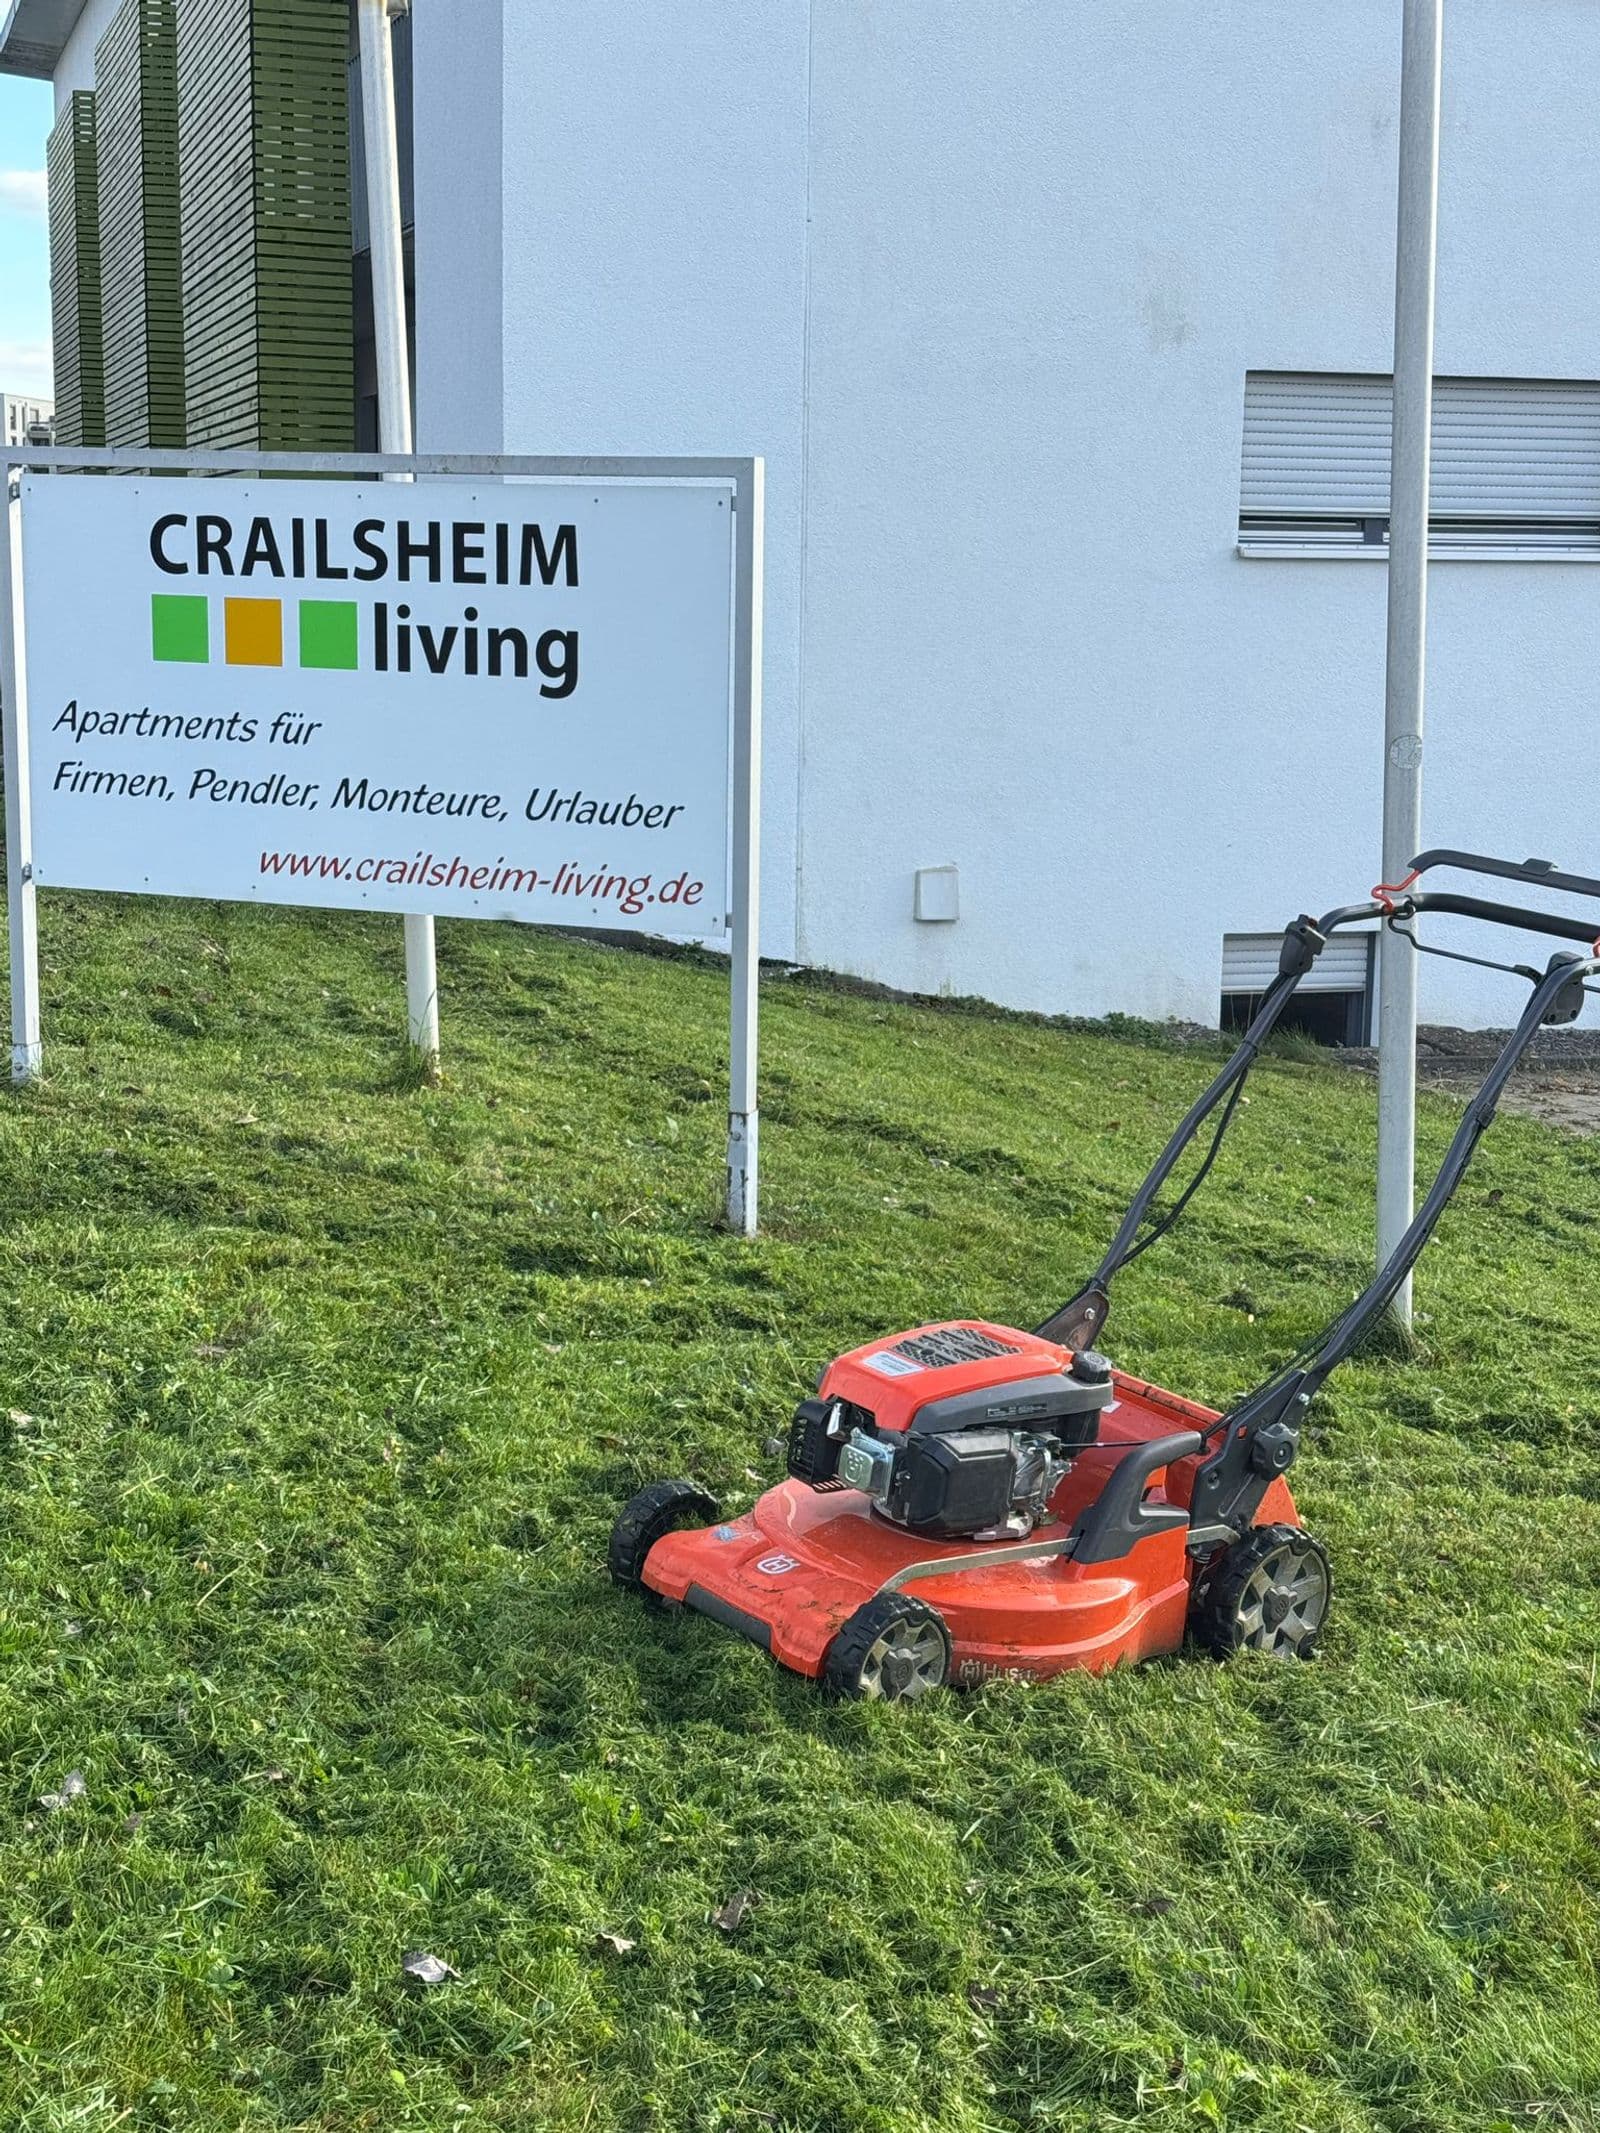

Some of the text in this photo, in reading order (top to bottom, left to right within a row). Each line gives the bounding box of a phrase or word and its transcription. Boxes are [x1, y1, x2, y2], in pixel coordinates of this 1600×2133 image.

[149, 513, 579, 588] CRAILSHEIM
[373, 601, 579, 700] living
[51, 699, 323, 746] Apartments für
[52, 760, 686, 829] Firmen, Pendler, Monteure, Urlauber
[260, 850, 704, 915] www.crailsheim-living.de
